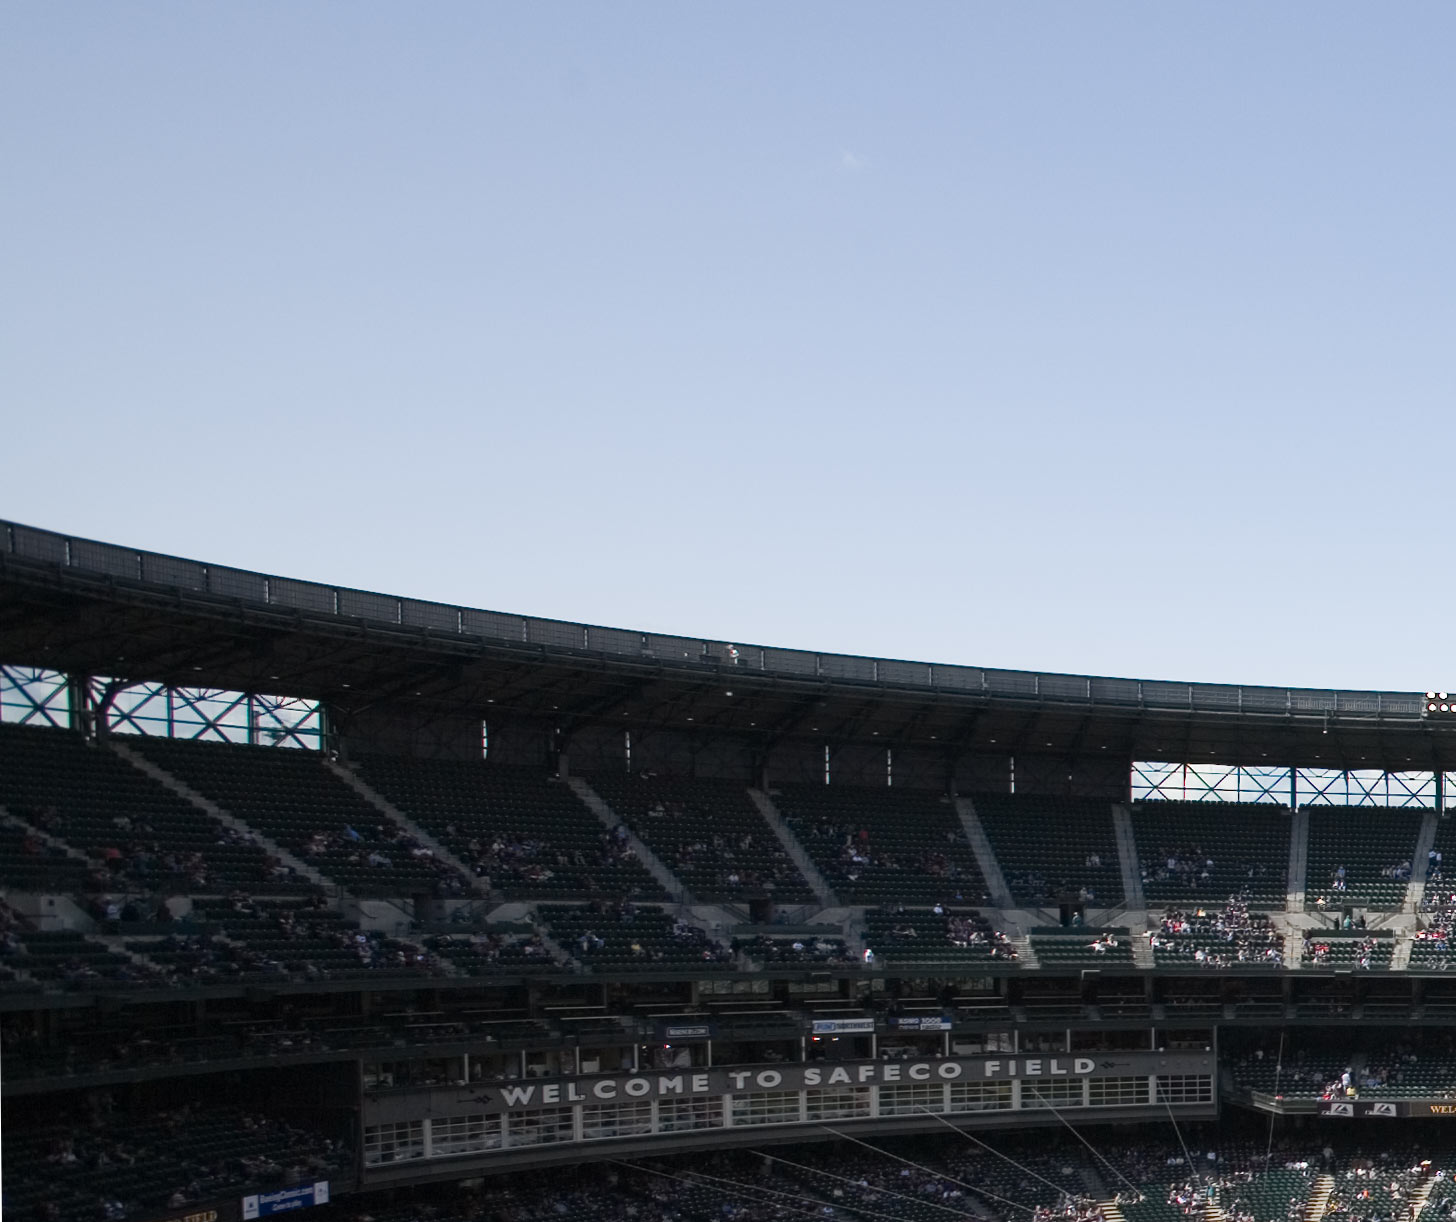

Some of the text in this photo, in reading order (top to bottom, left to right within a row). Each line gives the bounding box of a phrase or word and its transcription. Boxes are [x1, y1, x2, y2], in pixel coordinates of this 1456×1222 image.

[500, 1058, 1096, 1106] WELCOME TO SAFECO FIELD
